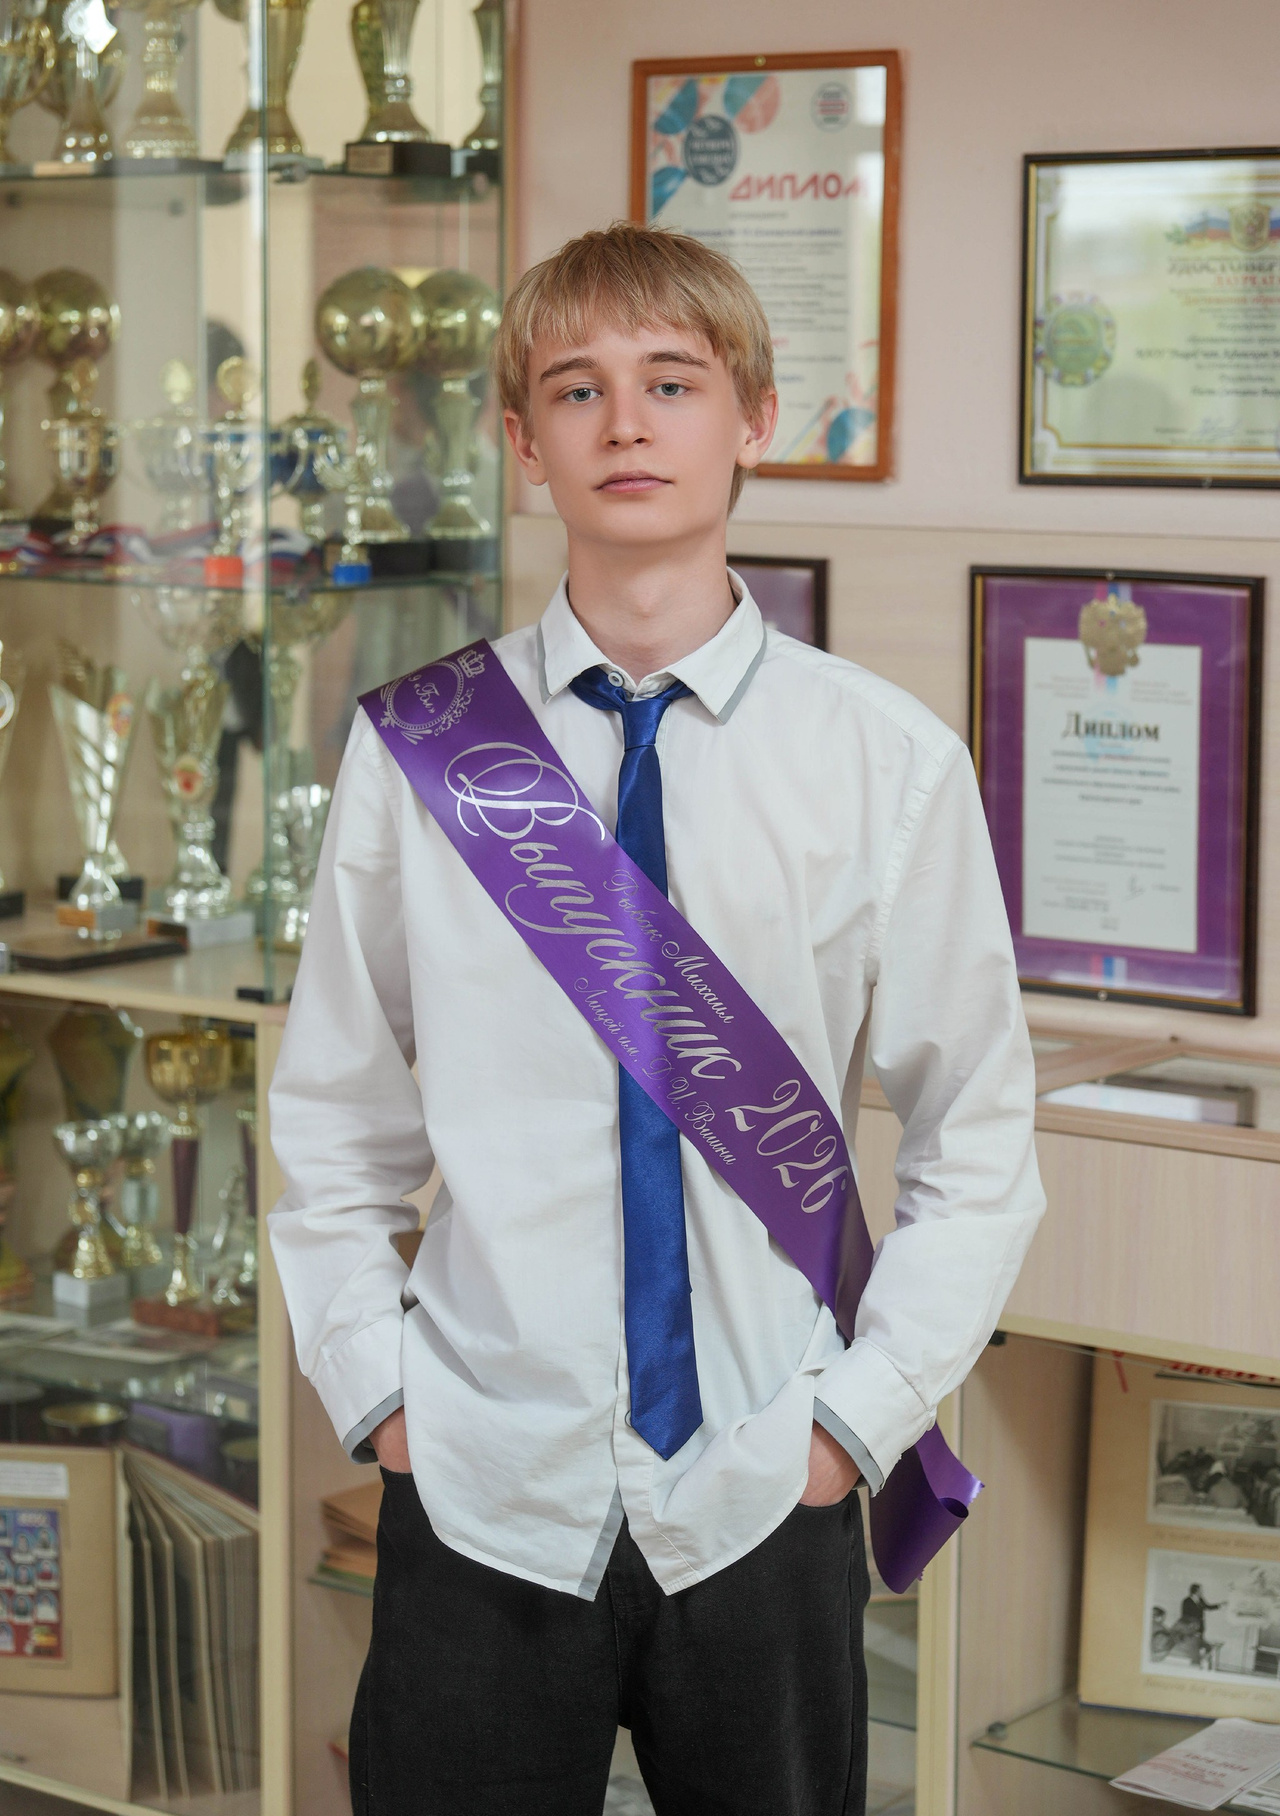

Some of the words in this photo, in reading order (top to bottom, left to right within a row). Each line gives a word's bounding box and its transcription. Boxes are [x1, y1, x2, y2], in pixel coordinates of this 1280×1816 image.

[1061, 710, 1159, 742] Диплом
[444, 741, 742, 1080] Выпускник
[724, 1079, 849, 1214] 2026
[603, 869, 663, 942] Рыбак
[661, 940, 735, 1024] Михаил
[574, 977, 625, 1036] Лицей
[617, 1035, 640, 1062] им.
[684, 1101, 737, 1166] Вишни
